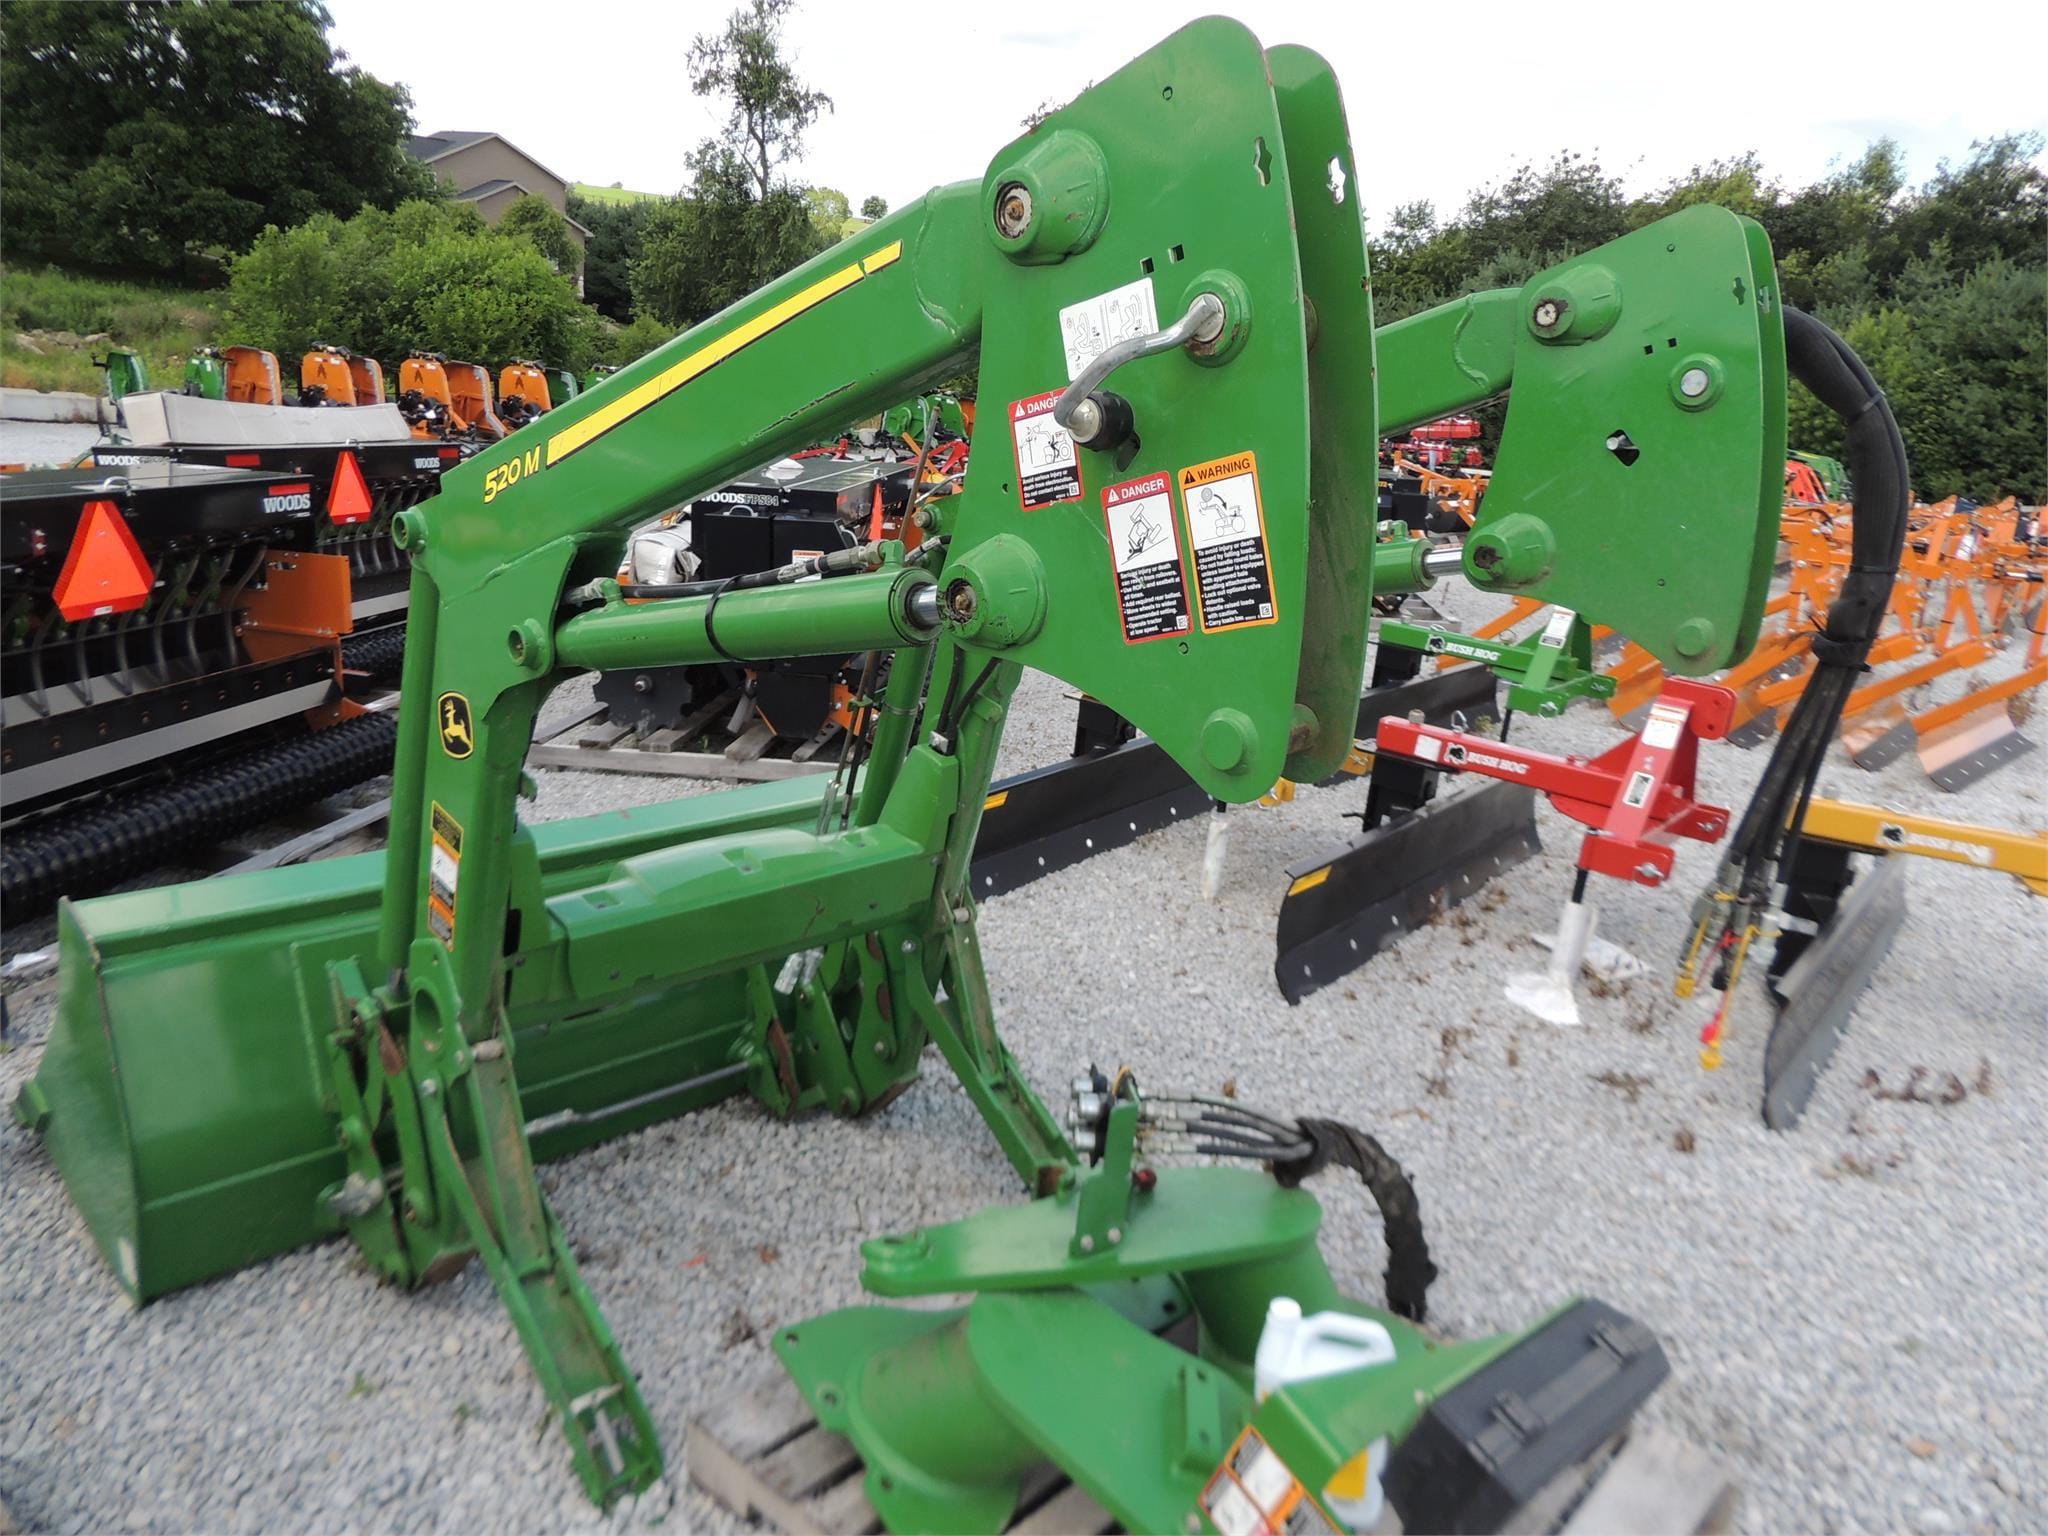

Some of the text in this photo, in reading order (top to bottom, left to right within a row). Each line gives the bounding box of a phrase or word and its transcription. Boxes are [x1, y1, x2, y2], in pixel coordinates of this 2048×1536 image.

[1027, 396, 1064, 414] DANGE
[97, 455, 140, 466] WOODS
[415, 457, 440, 469] WOODS
[1198, 458, 1251, 480] WARNING
[484, 443, 541, 504] 520 M
[1122, 478, 1165, 499] DANGER
[264, 494, 311, 513] WOODS
[1131, 576, 1144, 584] rest
[1473, 648, 1501, 661] HOG
